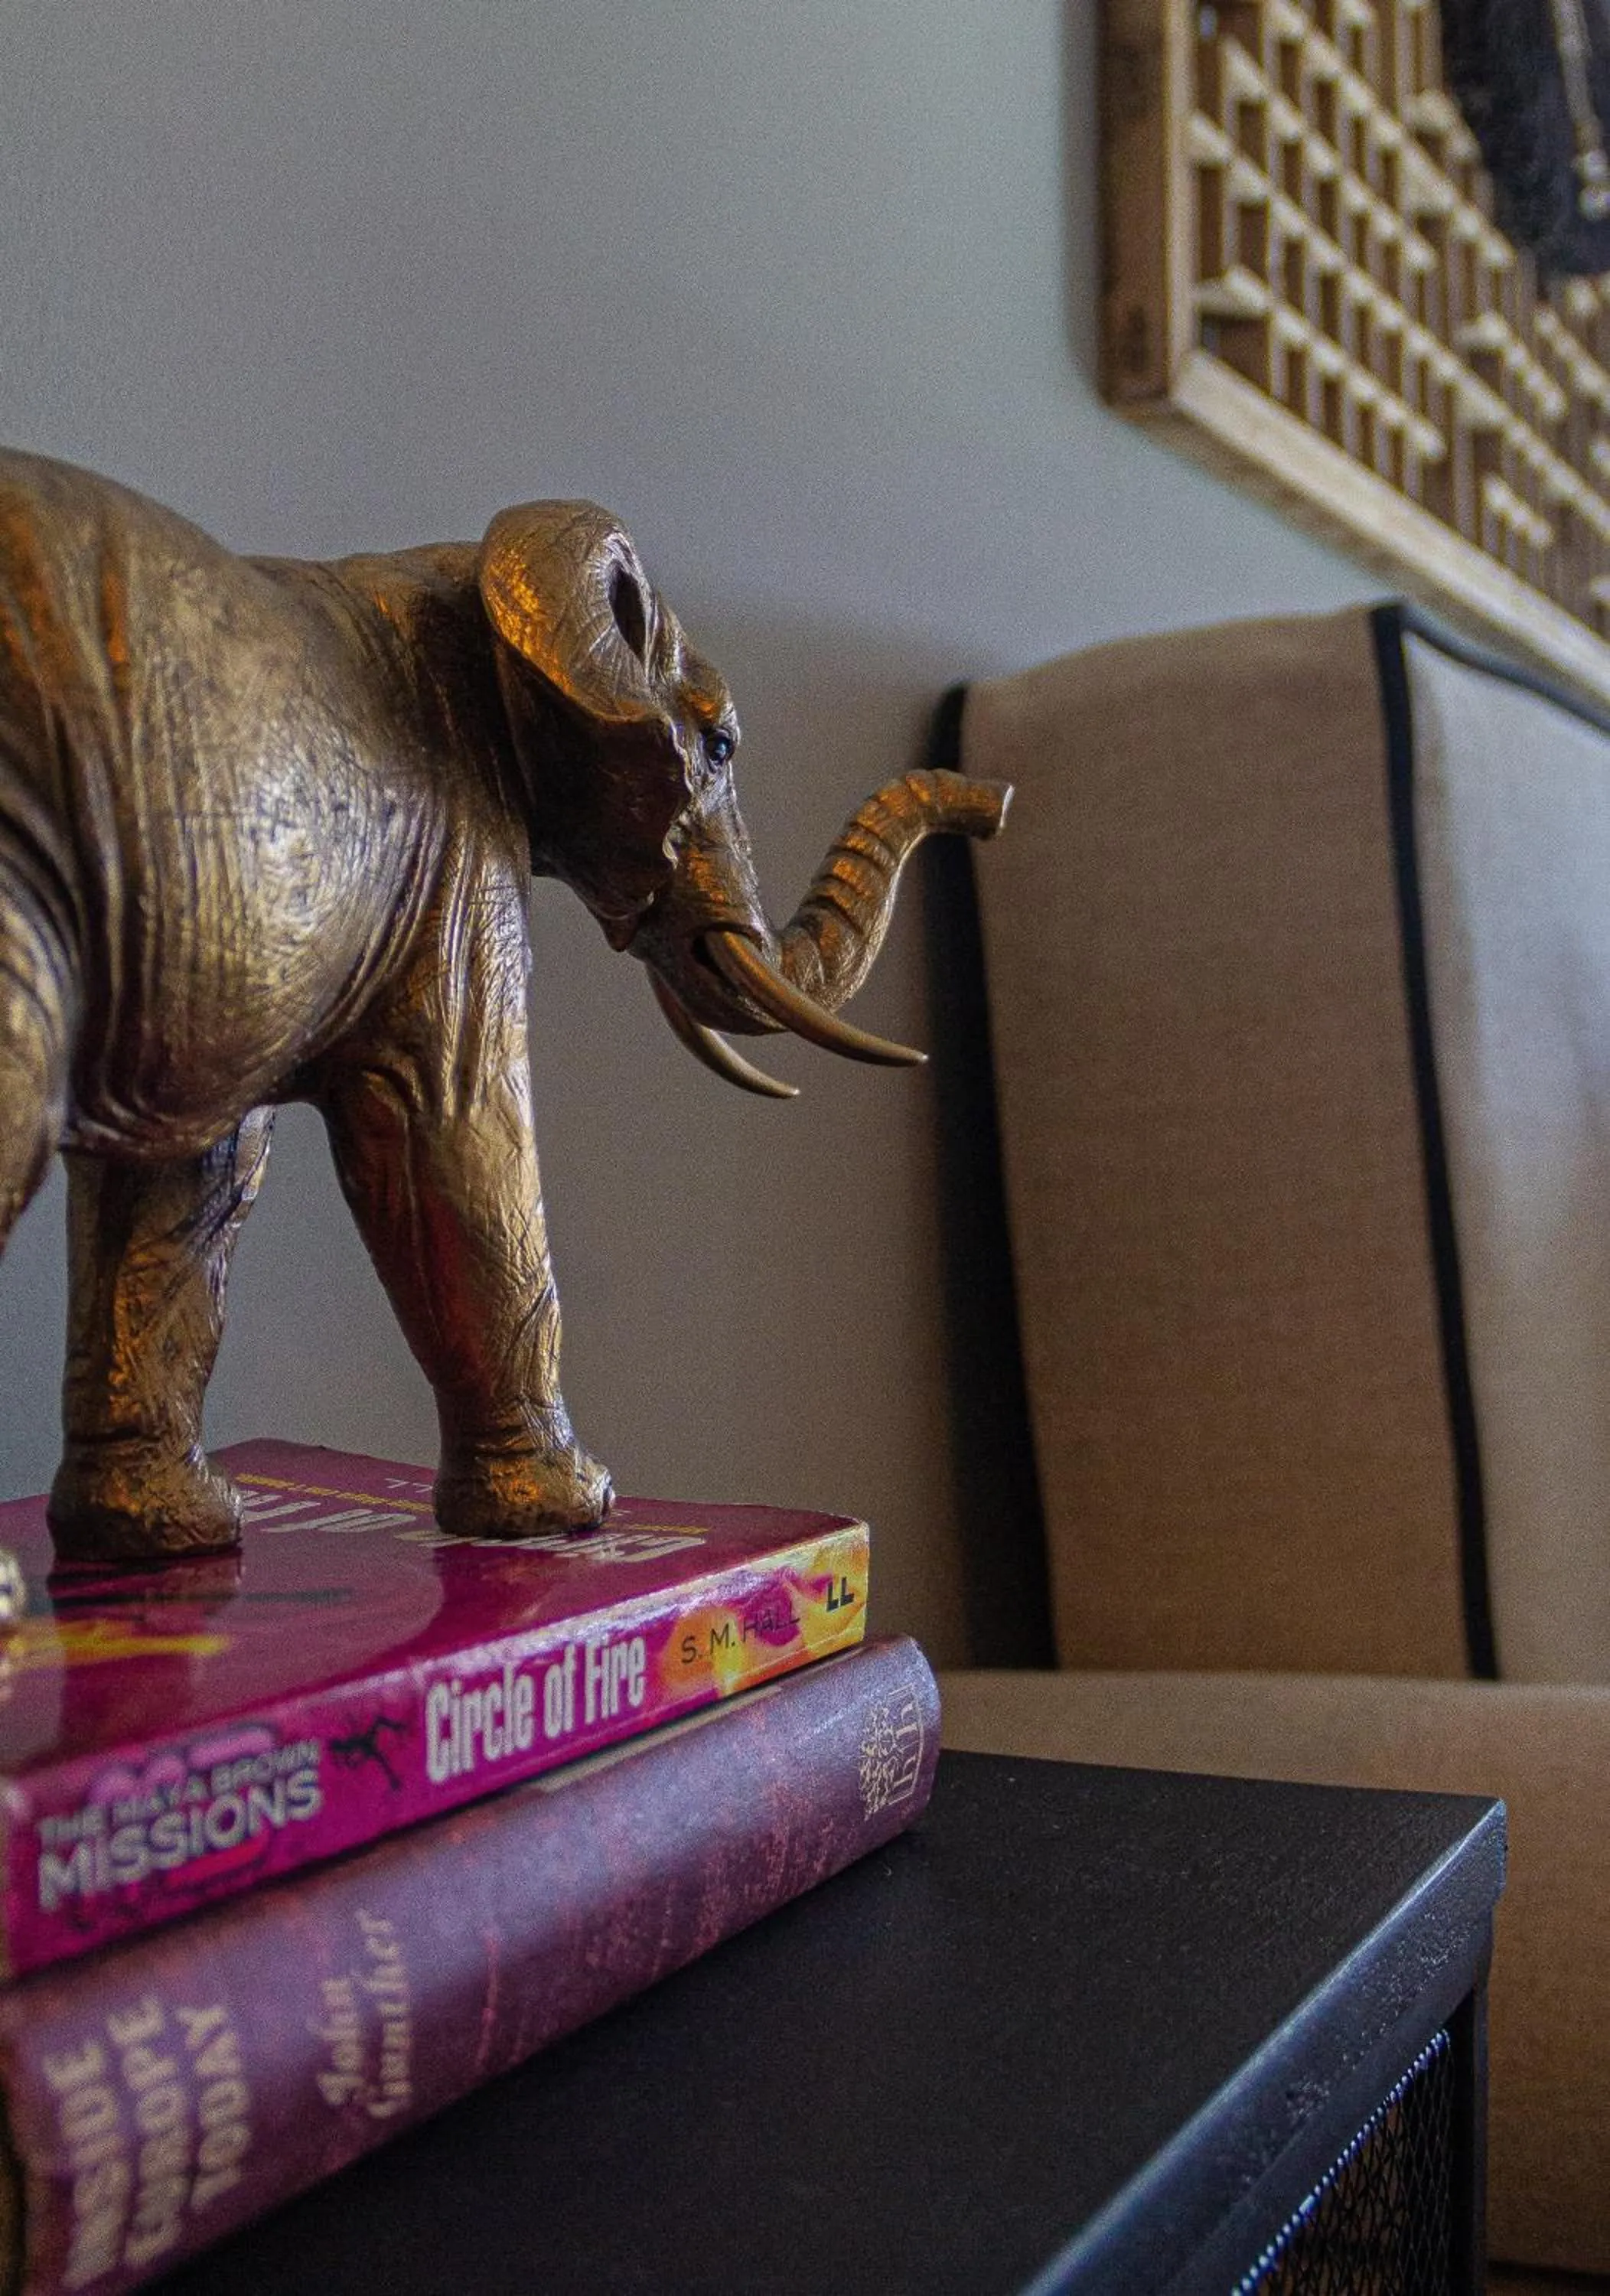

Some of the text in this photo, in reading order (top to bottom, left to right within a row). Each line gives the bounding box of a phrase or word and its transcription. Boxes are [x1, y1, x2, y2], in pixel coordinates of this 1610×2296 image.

[425, 1634, 647, 1784] Circle of Fire
[709, 1622, 736, 1657] M.
[37, 1767, 324, 1910] MISSIONS
